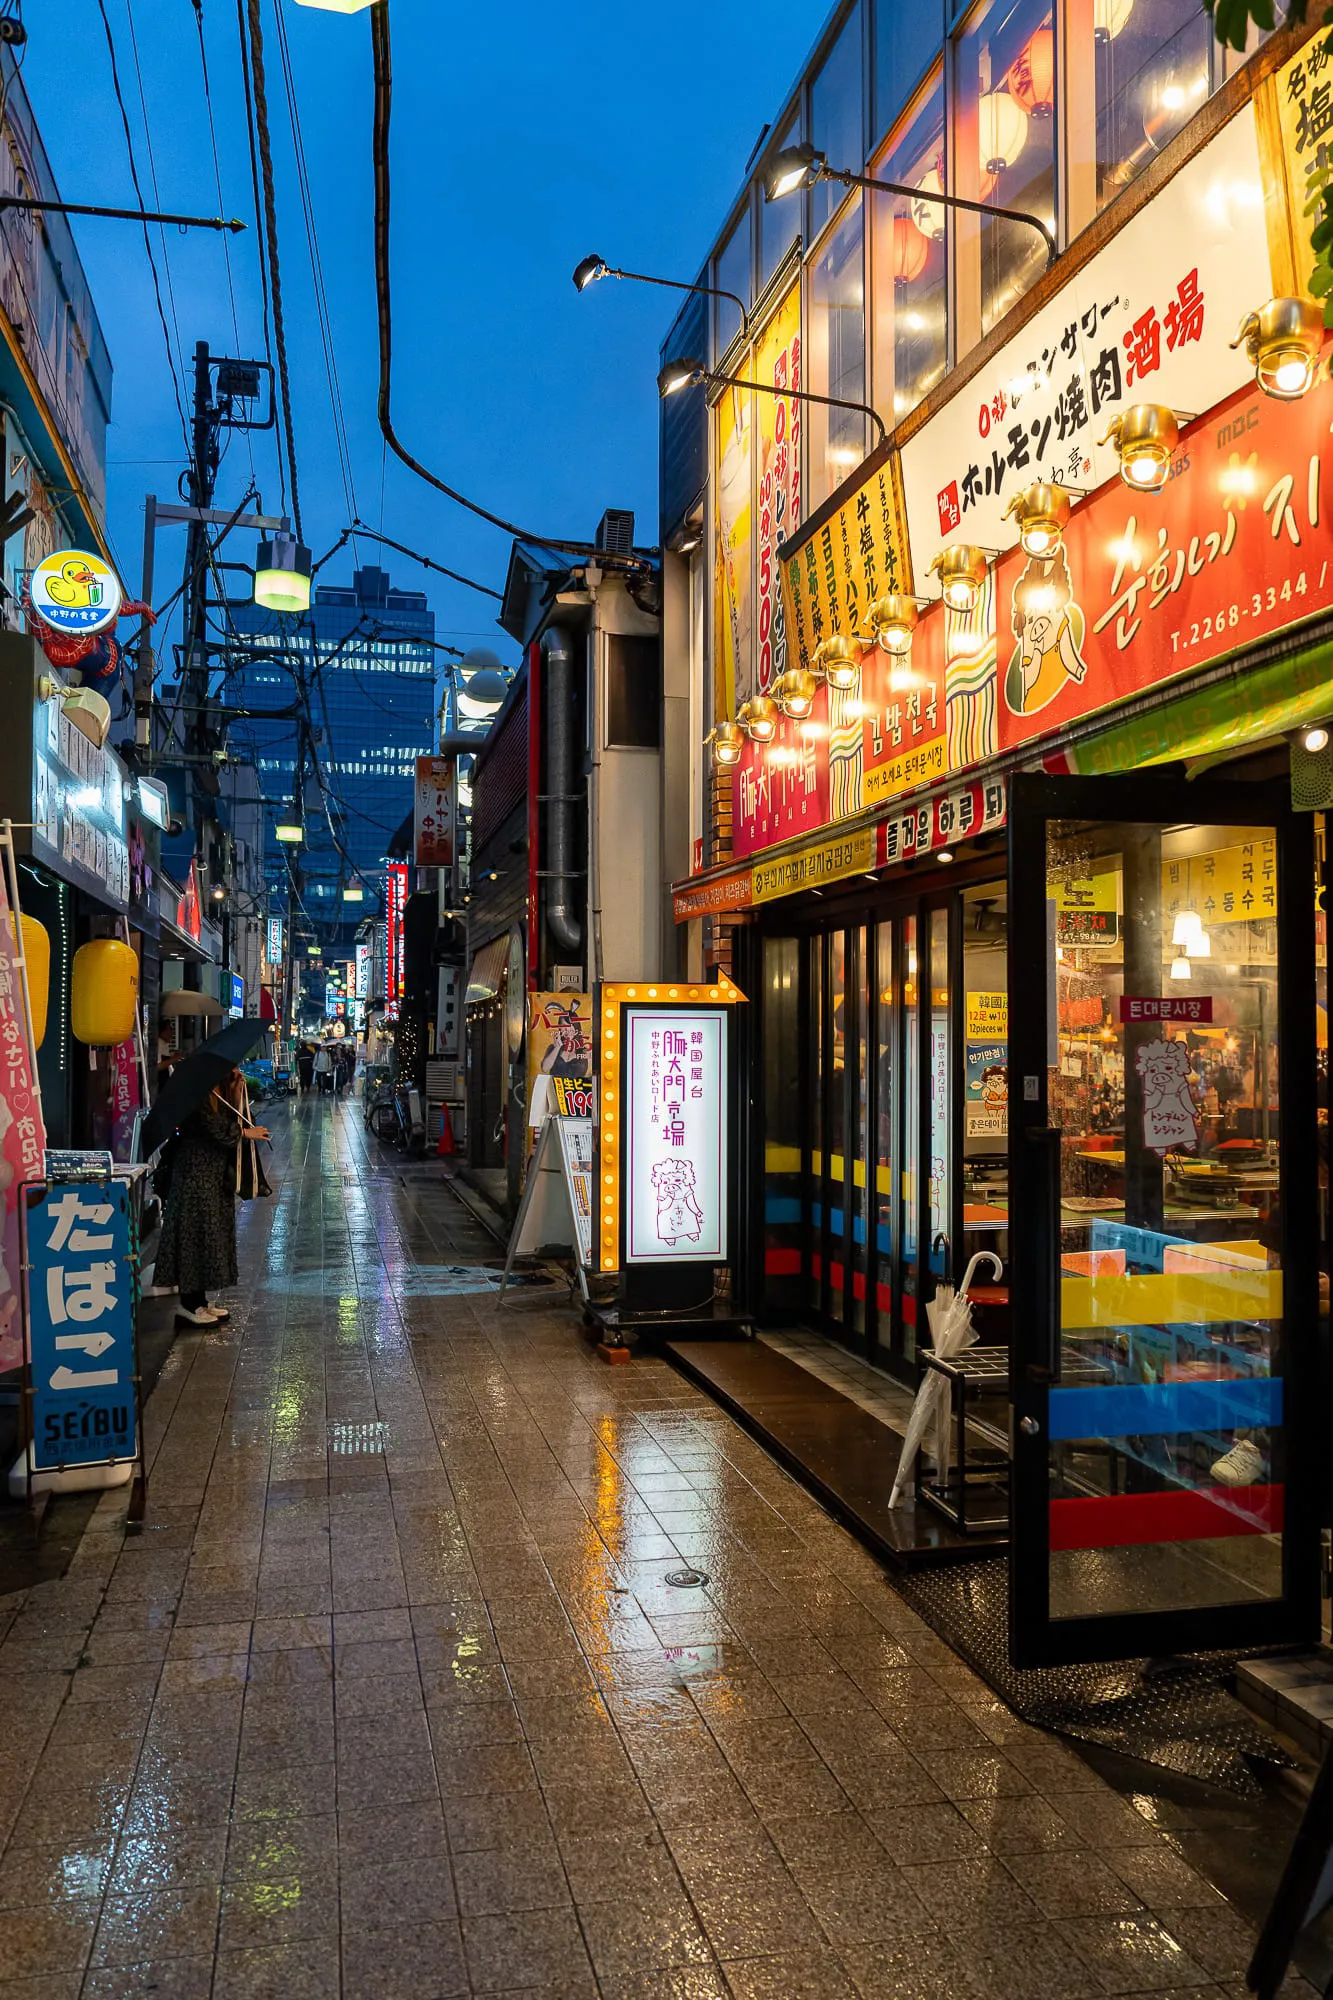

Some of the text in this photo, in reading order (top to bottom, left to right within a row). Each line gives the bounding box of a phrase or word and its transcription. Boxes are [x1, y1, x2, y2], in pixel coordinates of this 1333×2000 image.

[961, 267, 1205, 514] ホルモン焼肉酒場
[1168, 452, 1192, 483] SBS
[938, 493, 960, 527] 仙台
[759, 471, 772, 697] 60分500
[821, 525, 842, 634] コロコロホル
[840, 512, 860, 636] ときわ亭ハラ
[50, 609, 99, 621] 中野の食堂
[1170, 572, 1308, 652] T.2268-3344
[868, 681, 938, 758] 김밥천국
[905, 745, 944, 783] 돈대문시장
[887, 809, 930, 861] 즐거운
[938, 793, 974, 836] 하루
[969, 1023, 997, 1035] 12pieces
[1130, 1000, 1202, 1018] 돈대문시장
[651, 1031, 660, 1124] 中野ふれあいロード店
[690, 1031, 704, 1099] 韓国屋台
[969, 1119, 1000, 1130] 좋은데이
[1153, 1125, 1185, 1135] シジャン
[46, 1193, 118, 1391] たばこ
[44, 1401, 129, 1443] SEIBU
